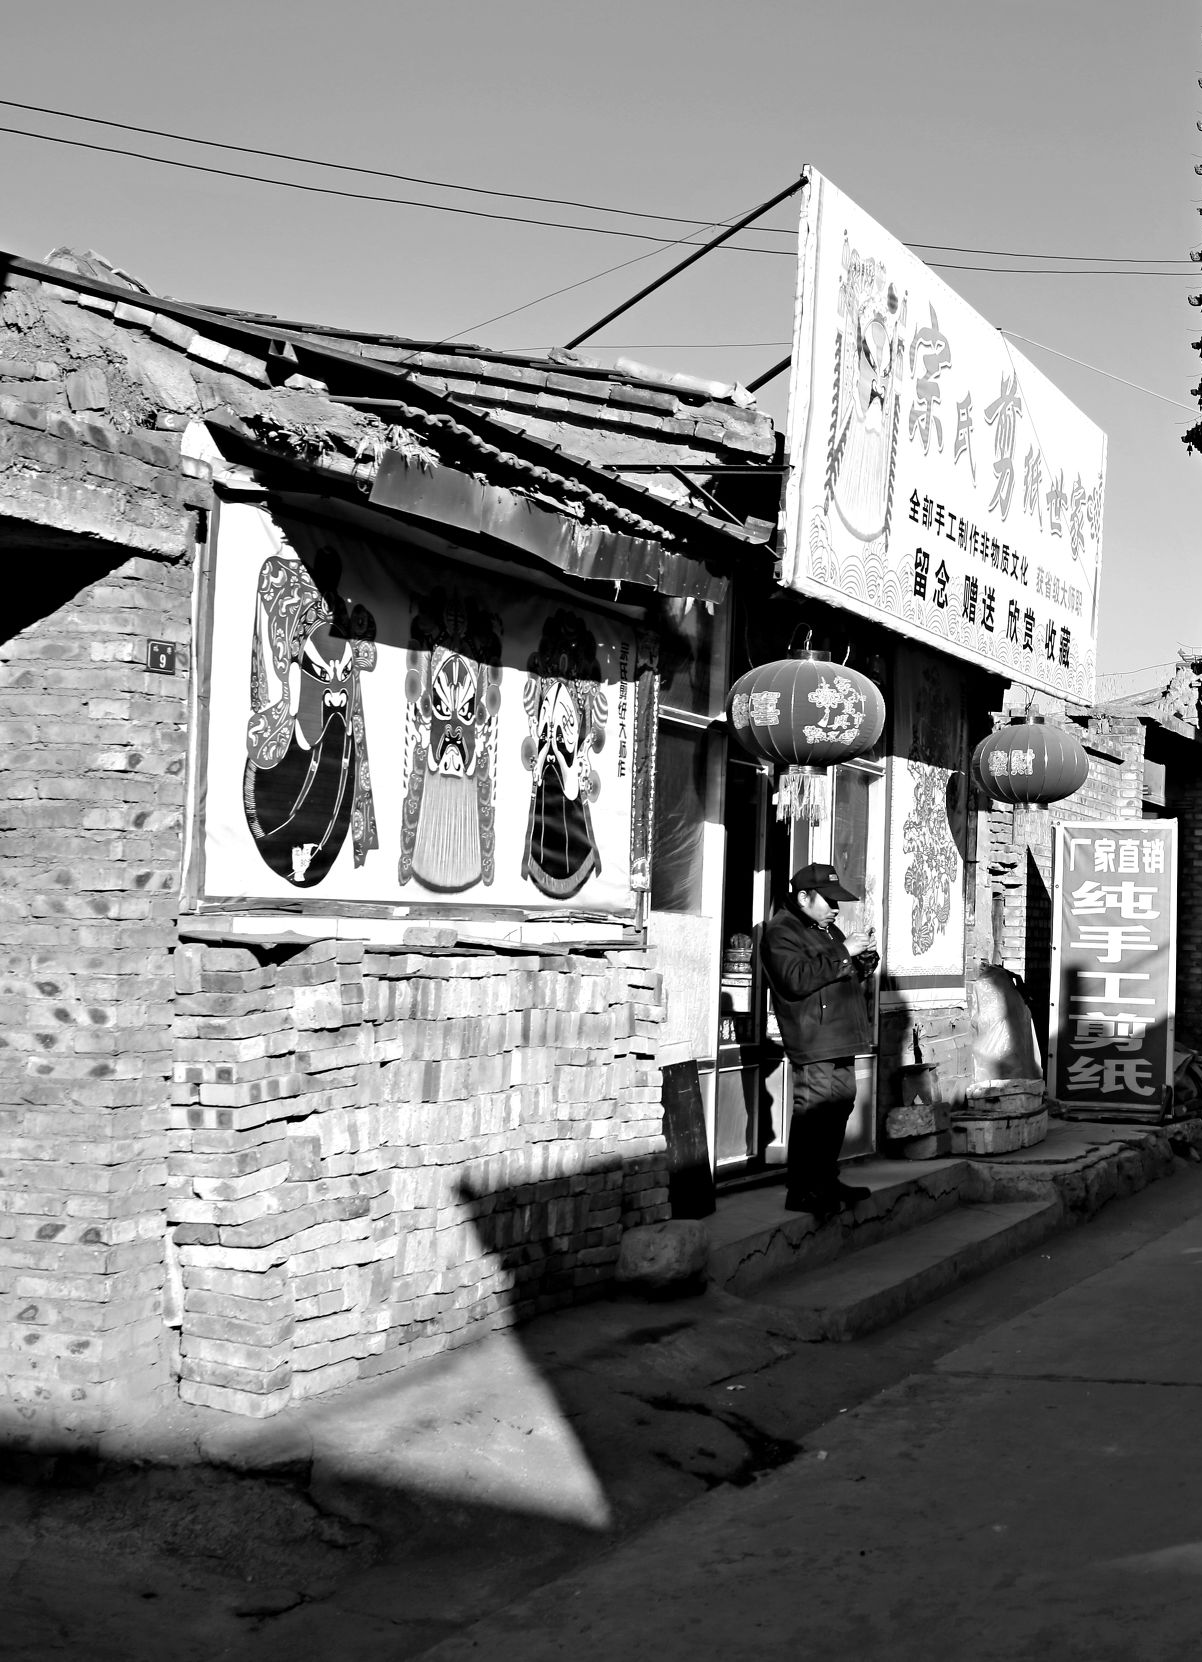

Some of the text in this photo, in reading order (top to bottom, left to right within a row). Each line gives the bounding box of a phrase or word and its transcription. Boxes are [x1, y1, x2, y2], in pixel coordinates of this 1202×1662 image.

[909, 488, 1029, 586] 全部手工制作非物质文化
[913, 547, 1071, 669] 留念 赠送 欣赏 收藏
[159, 653, 166, 668] 9
[1069, 838, 1165, 874] 厂家直销
[1066, 880, 1161, 1098] 纯手工剪纸
